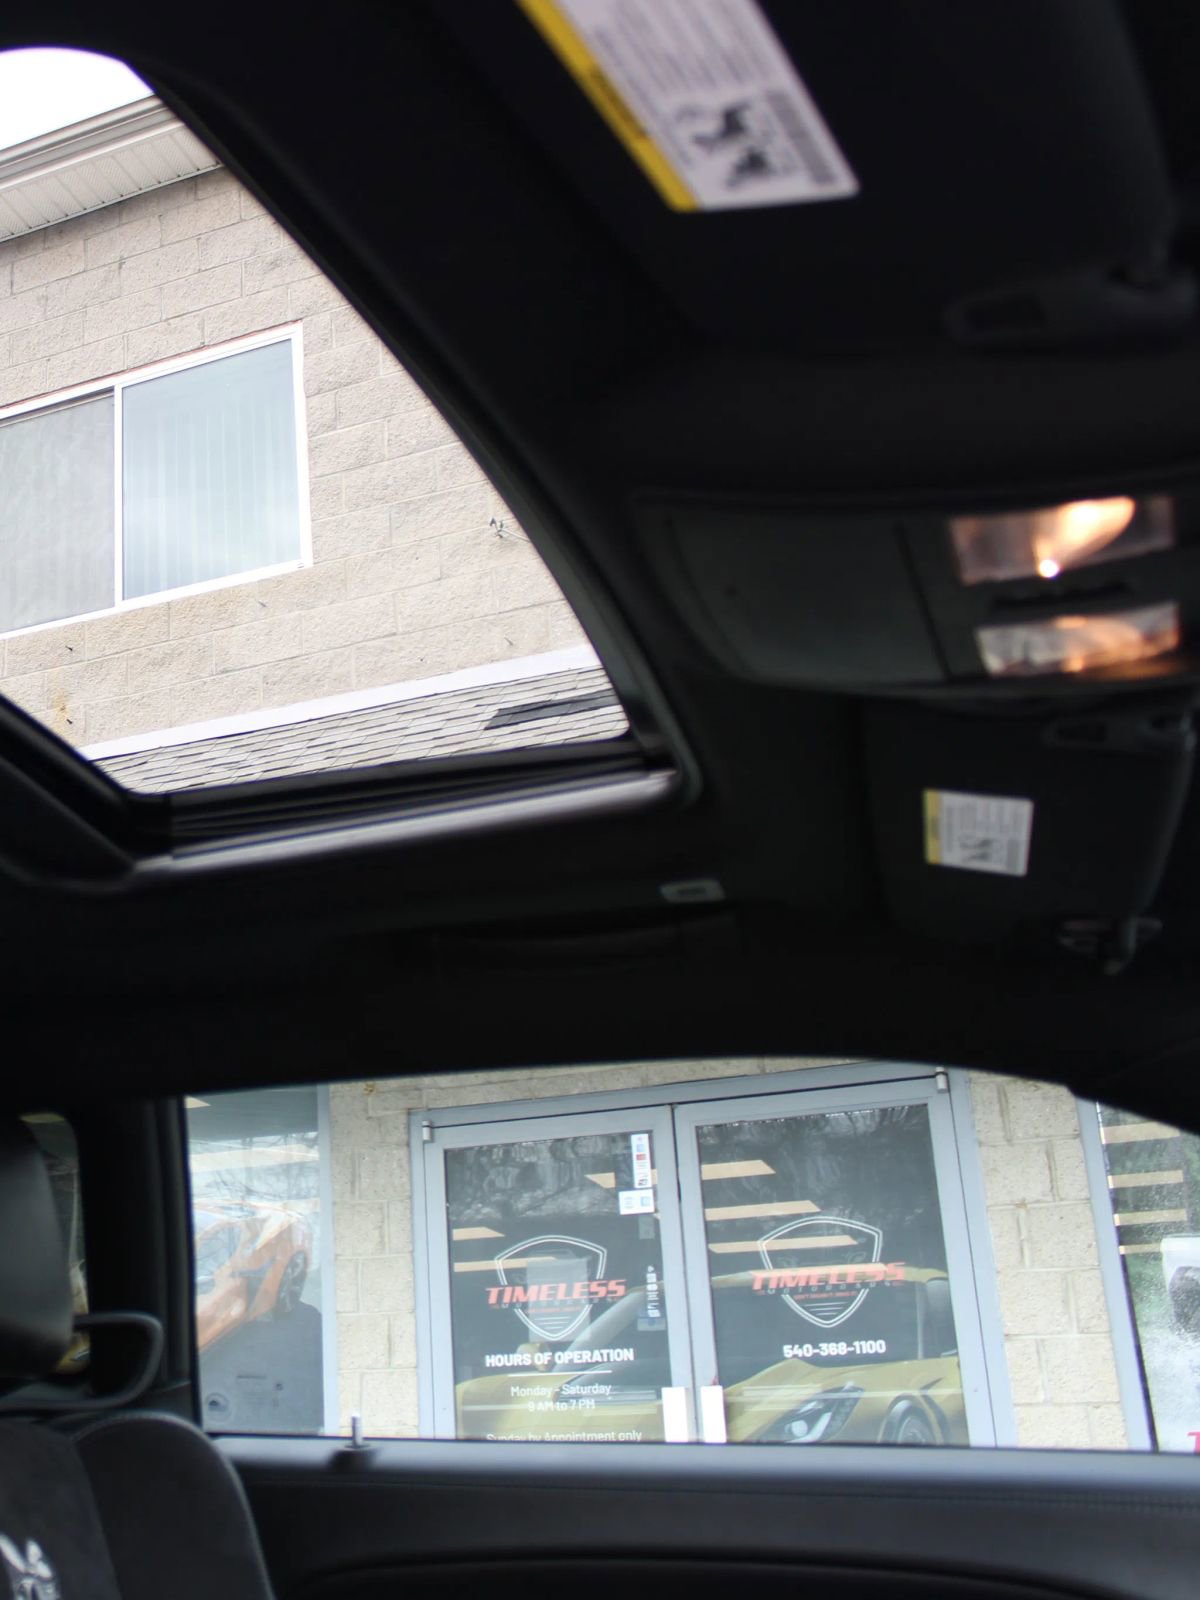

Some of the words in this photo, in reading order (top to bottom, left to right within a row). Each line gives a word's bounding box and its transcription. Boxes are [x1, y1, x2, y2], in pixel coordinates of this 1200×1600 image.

[751, 1262, 906, 1290] TIMELESS
[485, 1279, 627, 1305] TIMELESS
[485, 1354, 532, 1368] HOURS
[534, 1352, 552, 1365] OF
[554, 1348, 635, 1364] OPERATION
[782, 1339, 887, 1359] 540-368-1100
[510, 1385, 553, 1398] Monday
[561, 1383, 612, 1397] Saturday
[528, 1402, 535, 1412] 9
[537, 1401, 554, 1412] AM
[555, 1401, 567, 1412] to
[578, 1399, 595, 1410] PM
[618, 1429, 643, 1442] only
